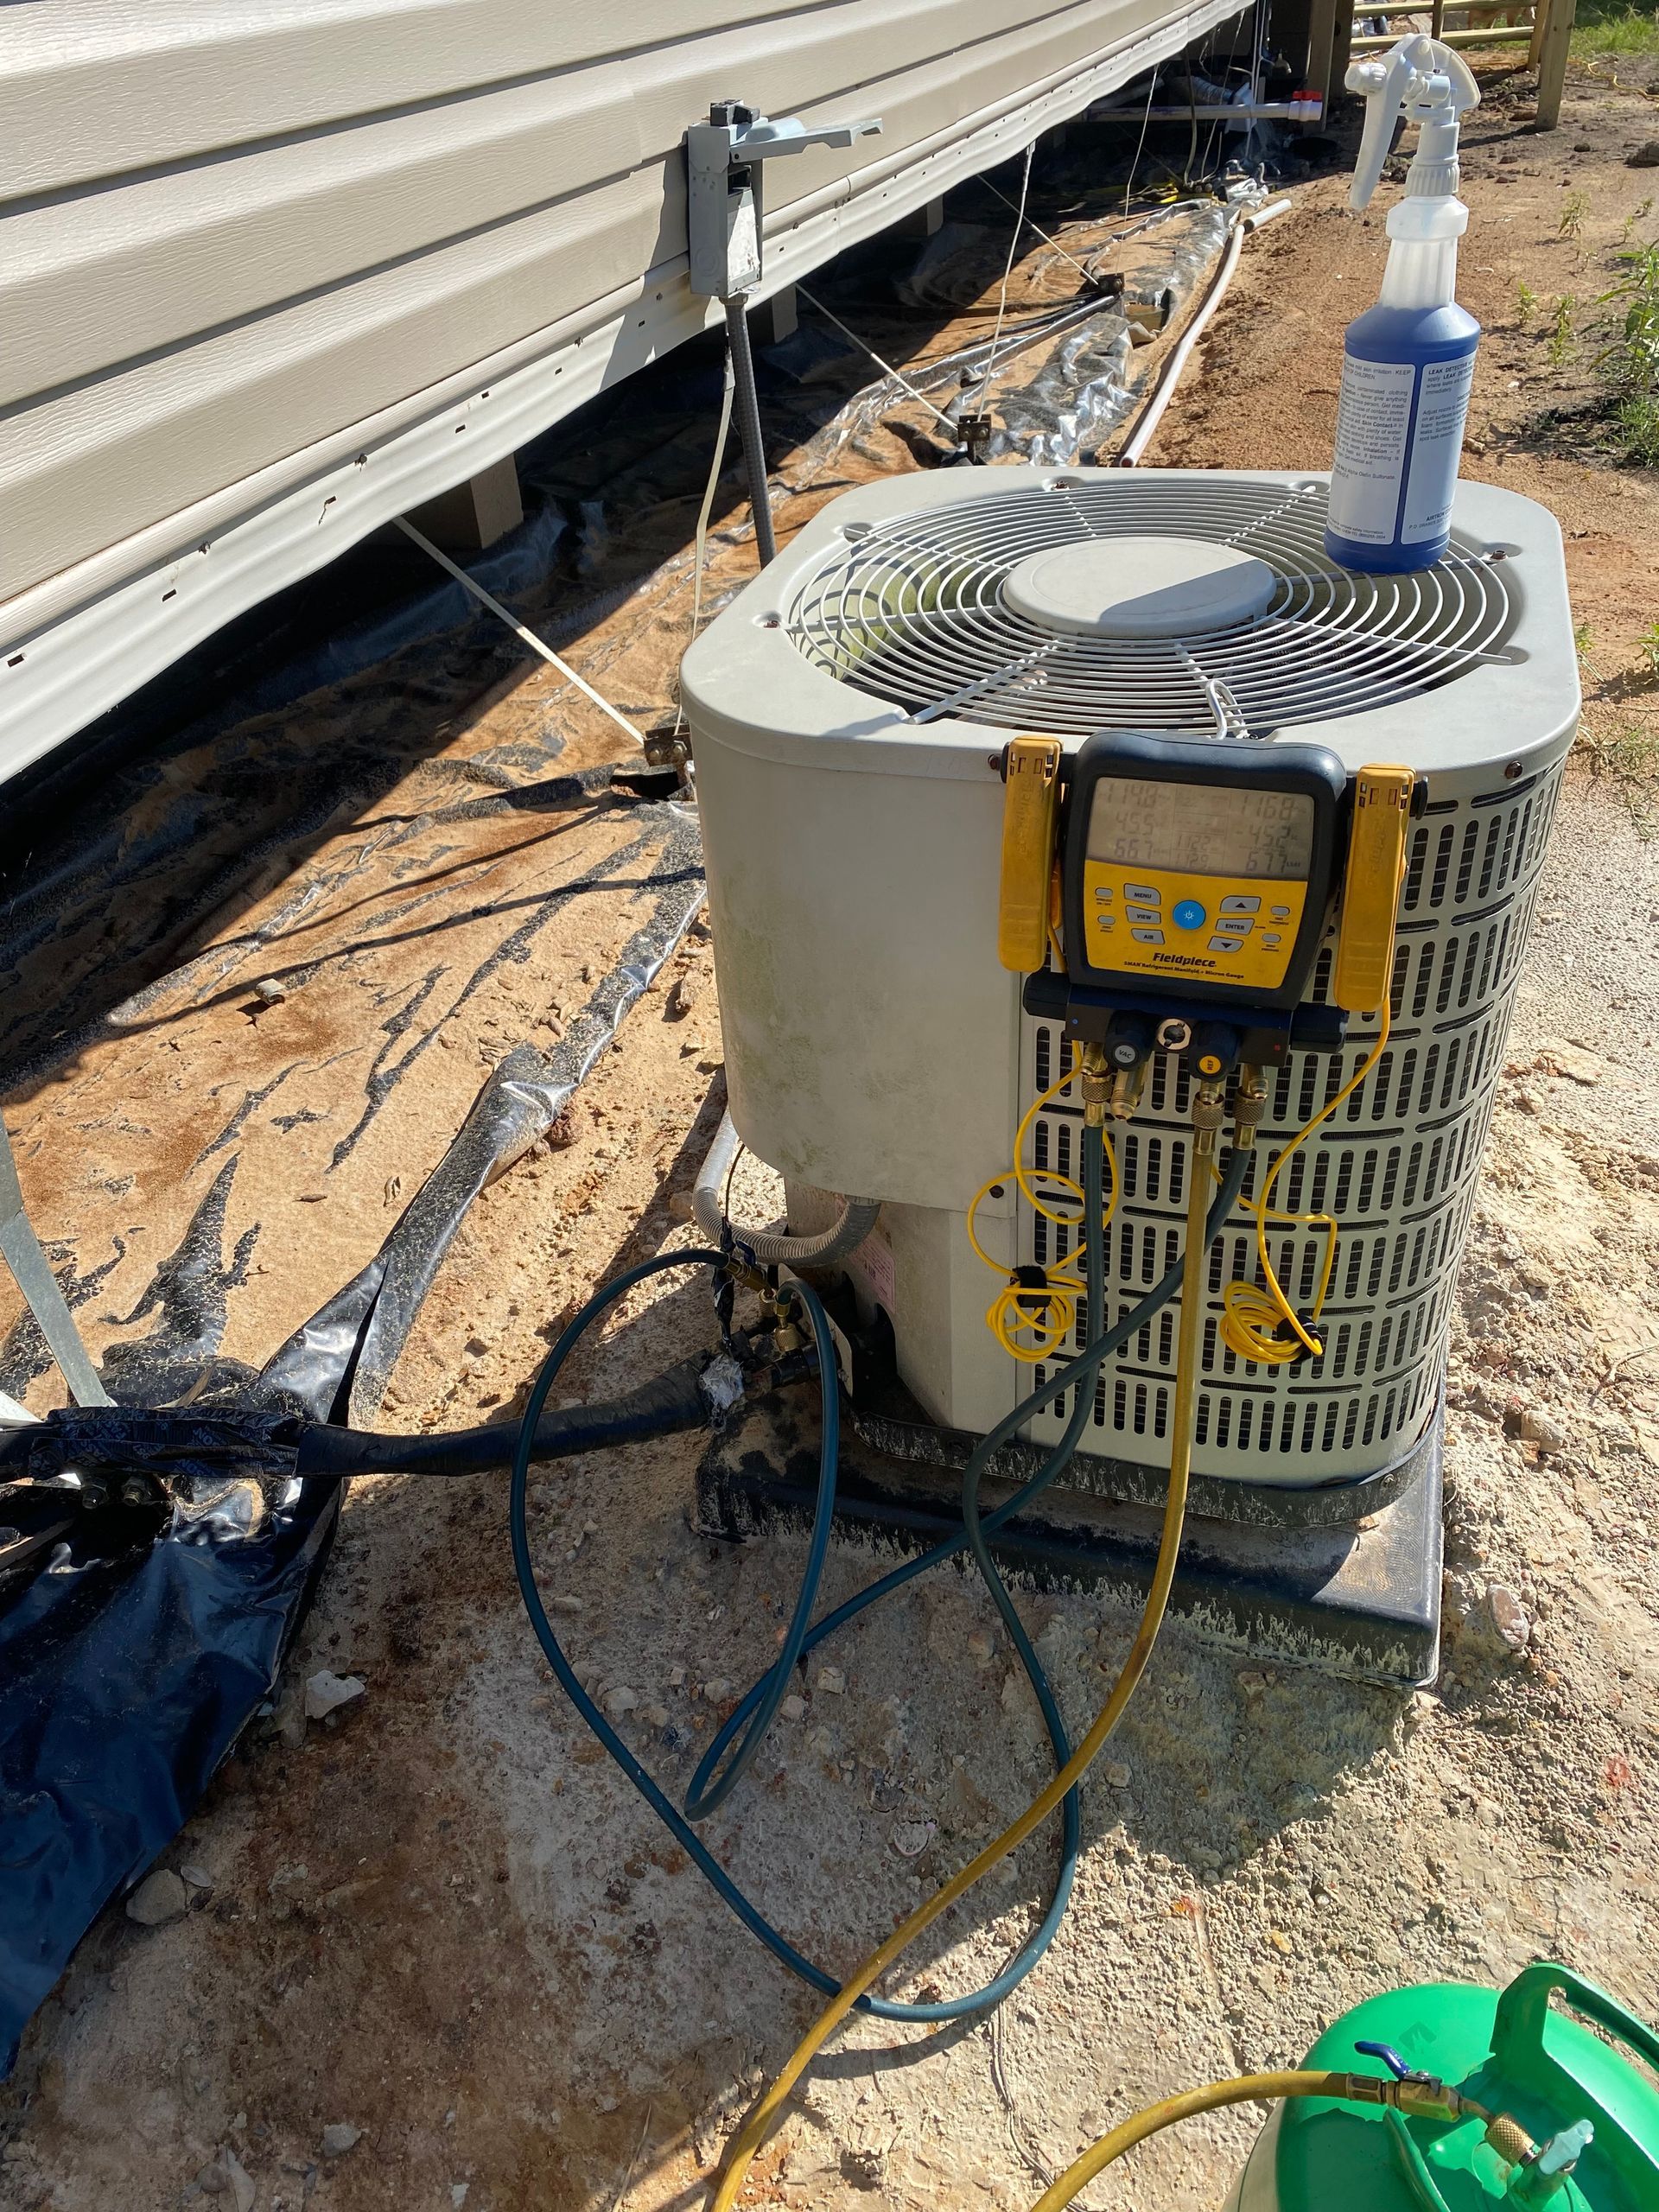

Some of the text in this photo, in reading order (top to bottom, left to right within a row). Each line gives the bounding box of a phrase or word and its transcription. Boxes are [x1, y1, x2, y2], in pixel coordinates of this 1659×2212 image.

[1152, 952, 1216, 968] Fieldpiece
[1141, 963, 1174, 971] Refrigerant
[1174, 966, 1200, 975] Manifold
[1119, 1049, 1132, 1059] VAC
